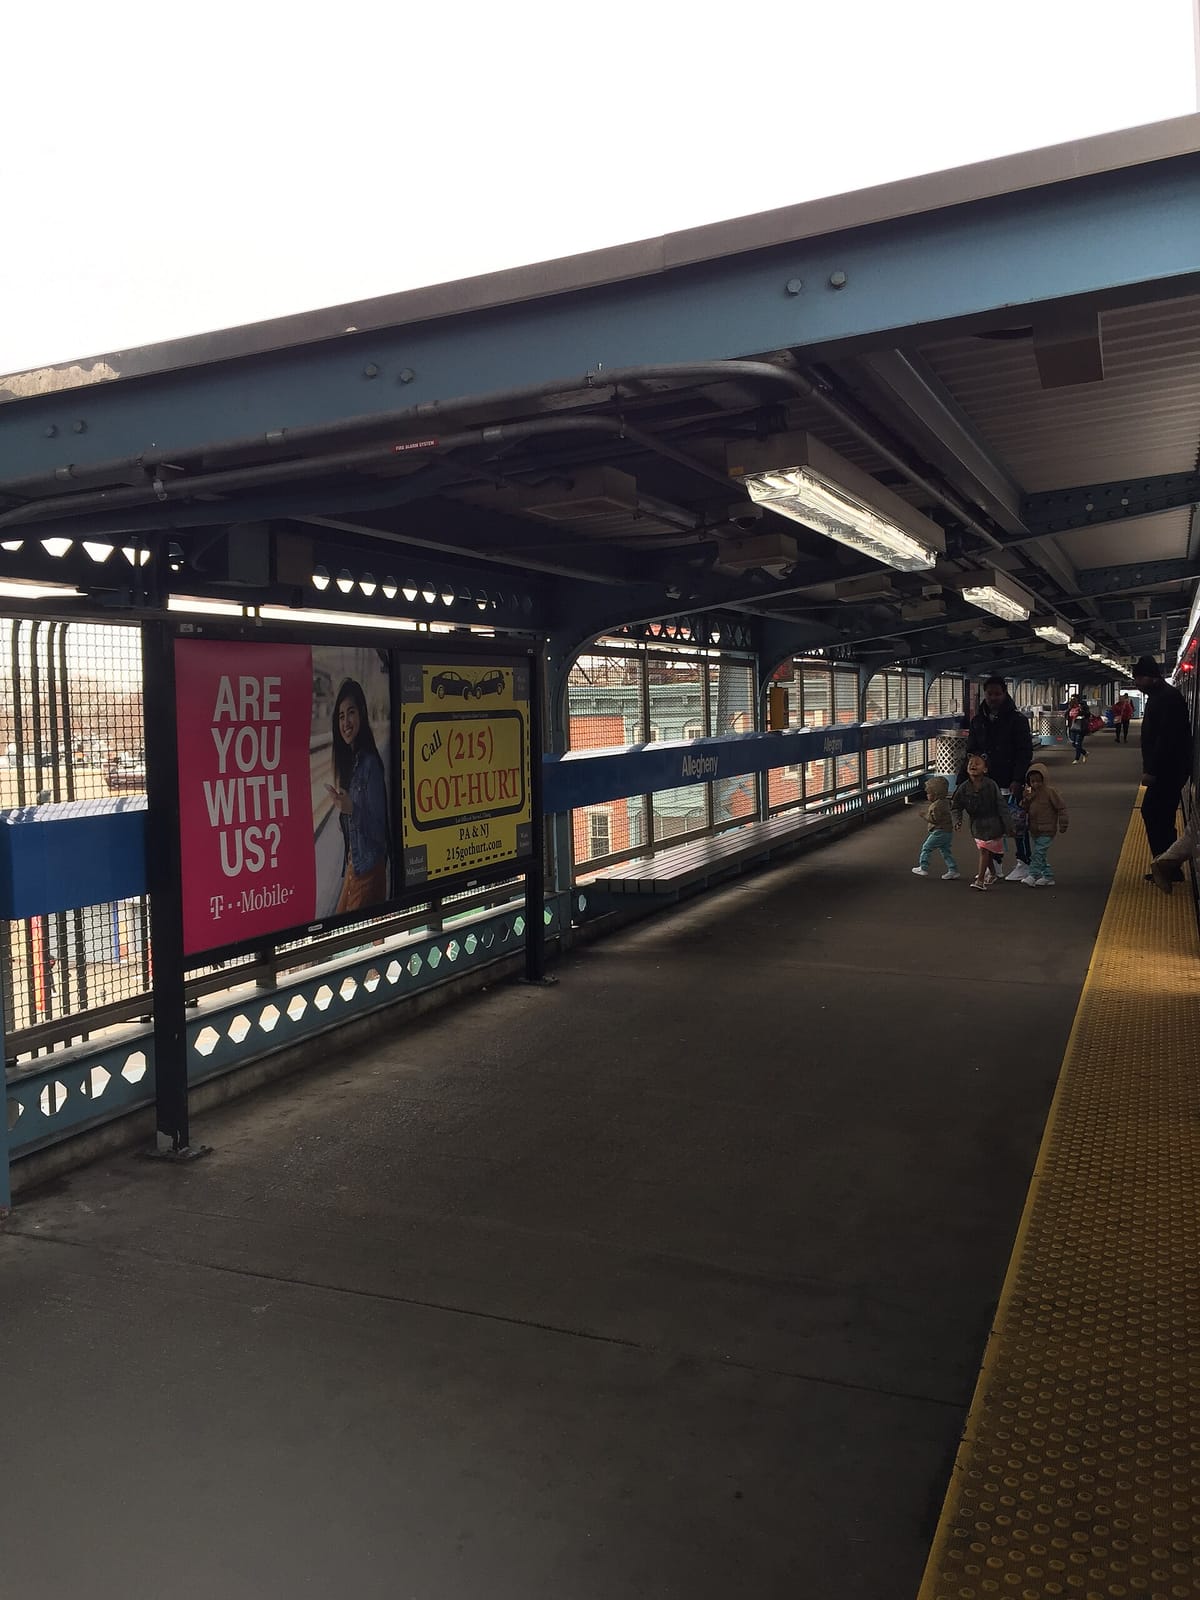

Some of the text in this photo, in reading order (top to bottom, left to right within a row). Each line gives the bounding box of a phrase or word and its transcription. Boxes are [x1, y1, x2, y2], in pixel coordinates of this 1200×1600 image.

[212, 675, 281, 722] ARE
[211, 726, 282, 774] YOU
[421, 726, 494, 768] Call (215)
[681, 754, 719, 778] Allegheny
[823, 737, 843, 754] Allegheny
[203, 774, 290, 827] WITH
[416, 767, 520, 813] GOT-HURT
[219, 823, 282, 877] US?
[446, 839, 502, 861] 215gothurt.com
[459, 824, 490, 840] PA & NJ
